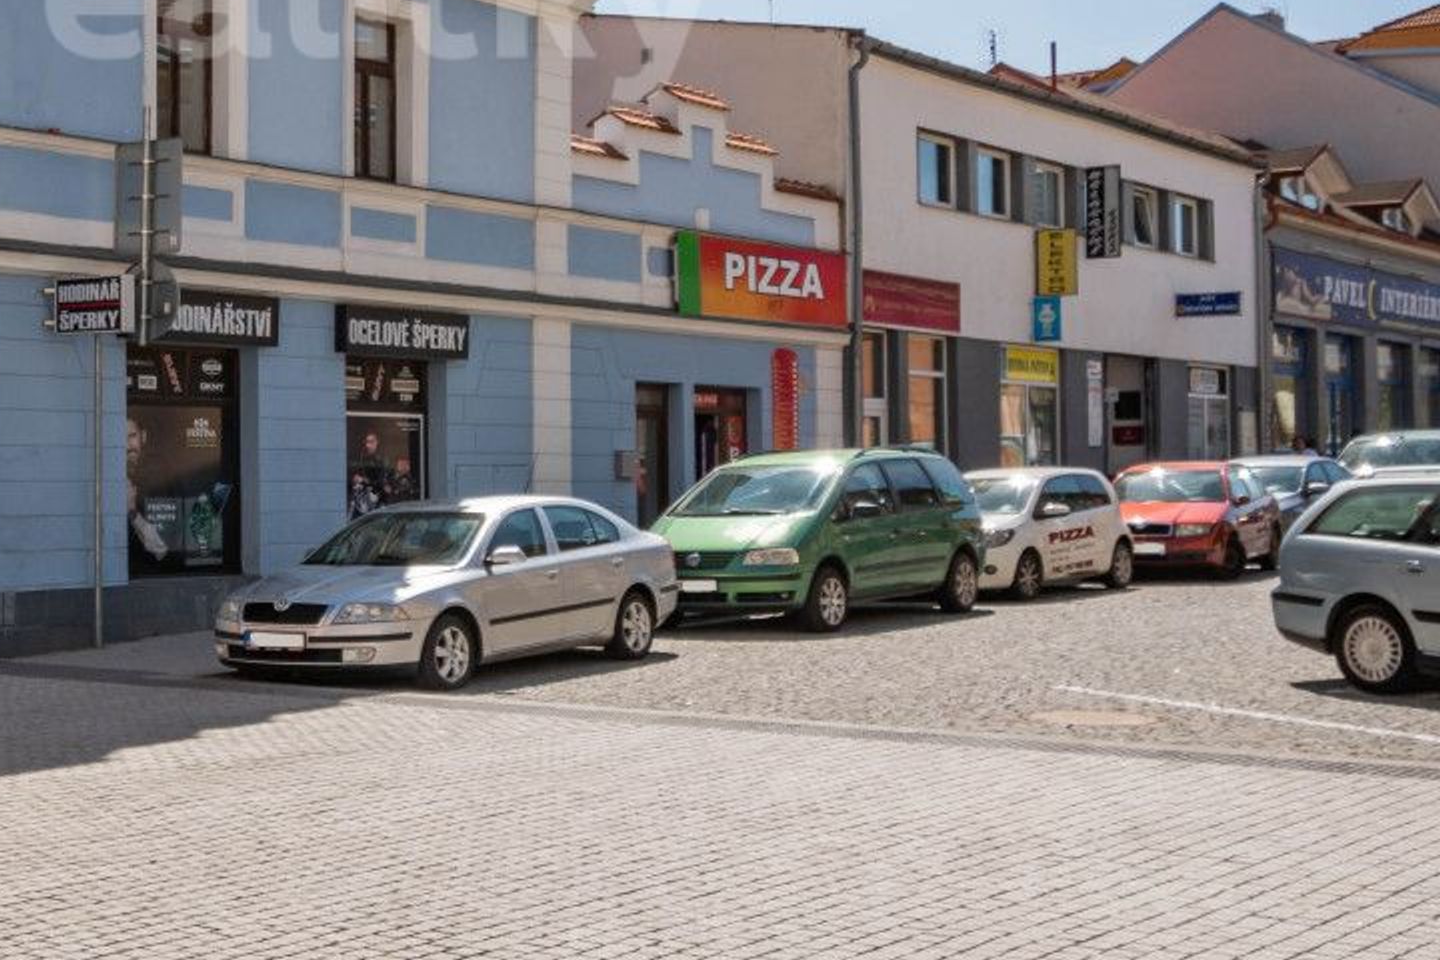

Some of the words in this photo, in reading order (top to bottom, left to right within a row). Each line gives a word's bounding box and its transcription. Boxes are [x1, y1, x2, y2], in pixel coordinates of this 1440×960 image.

[59, 278, 120, 303] HODINÁŘ
[724, 252, 824, 300] PIZZA
[1324, 275, 1366, 309] PAVEL
[59, 309, 119, 330] ŠPERKY
[171, 301, 271, 338] ODINÁŘSTVÍ
[348, 317, 411, 349] OCELOVÉ
[412, 315, 467, 352] ŠPERKY
[1048, 526, 1095, 544] PIZZA
